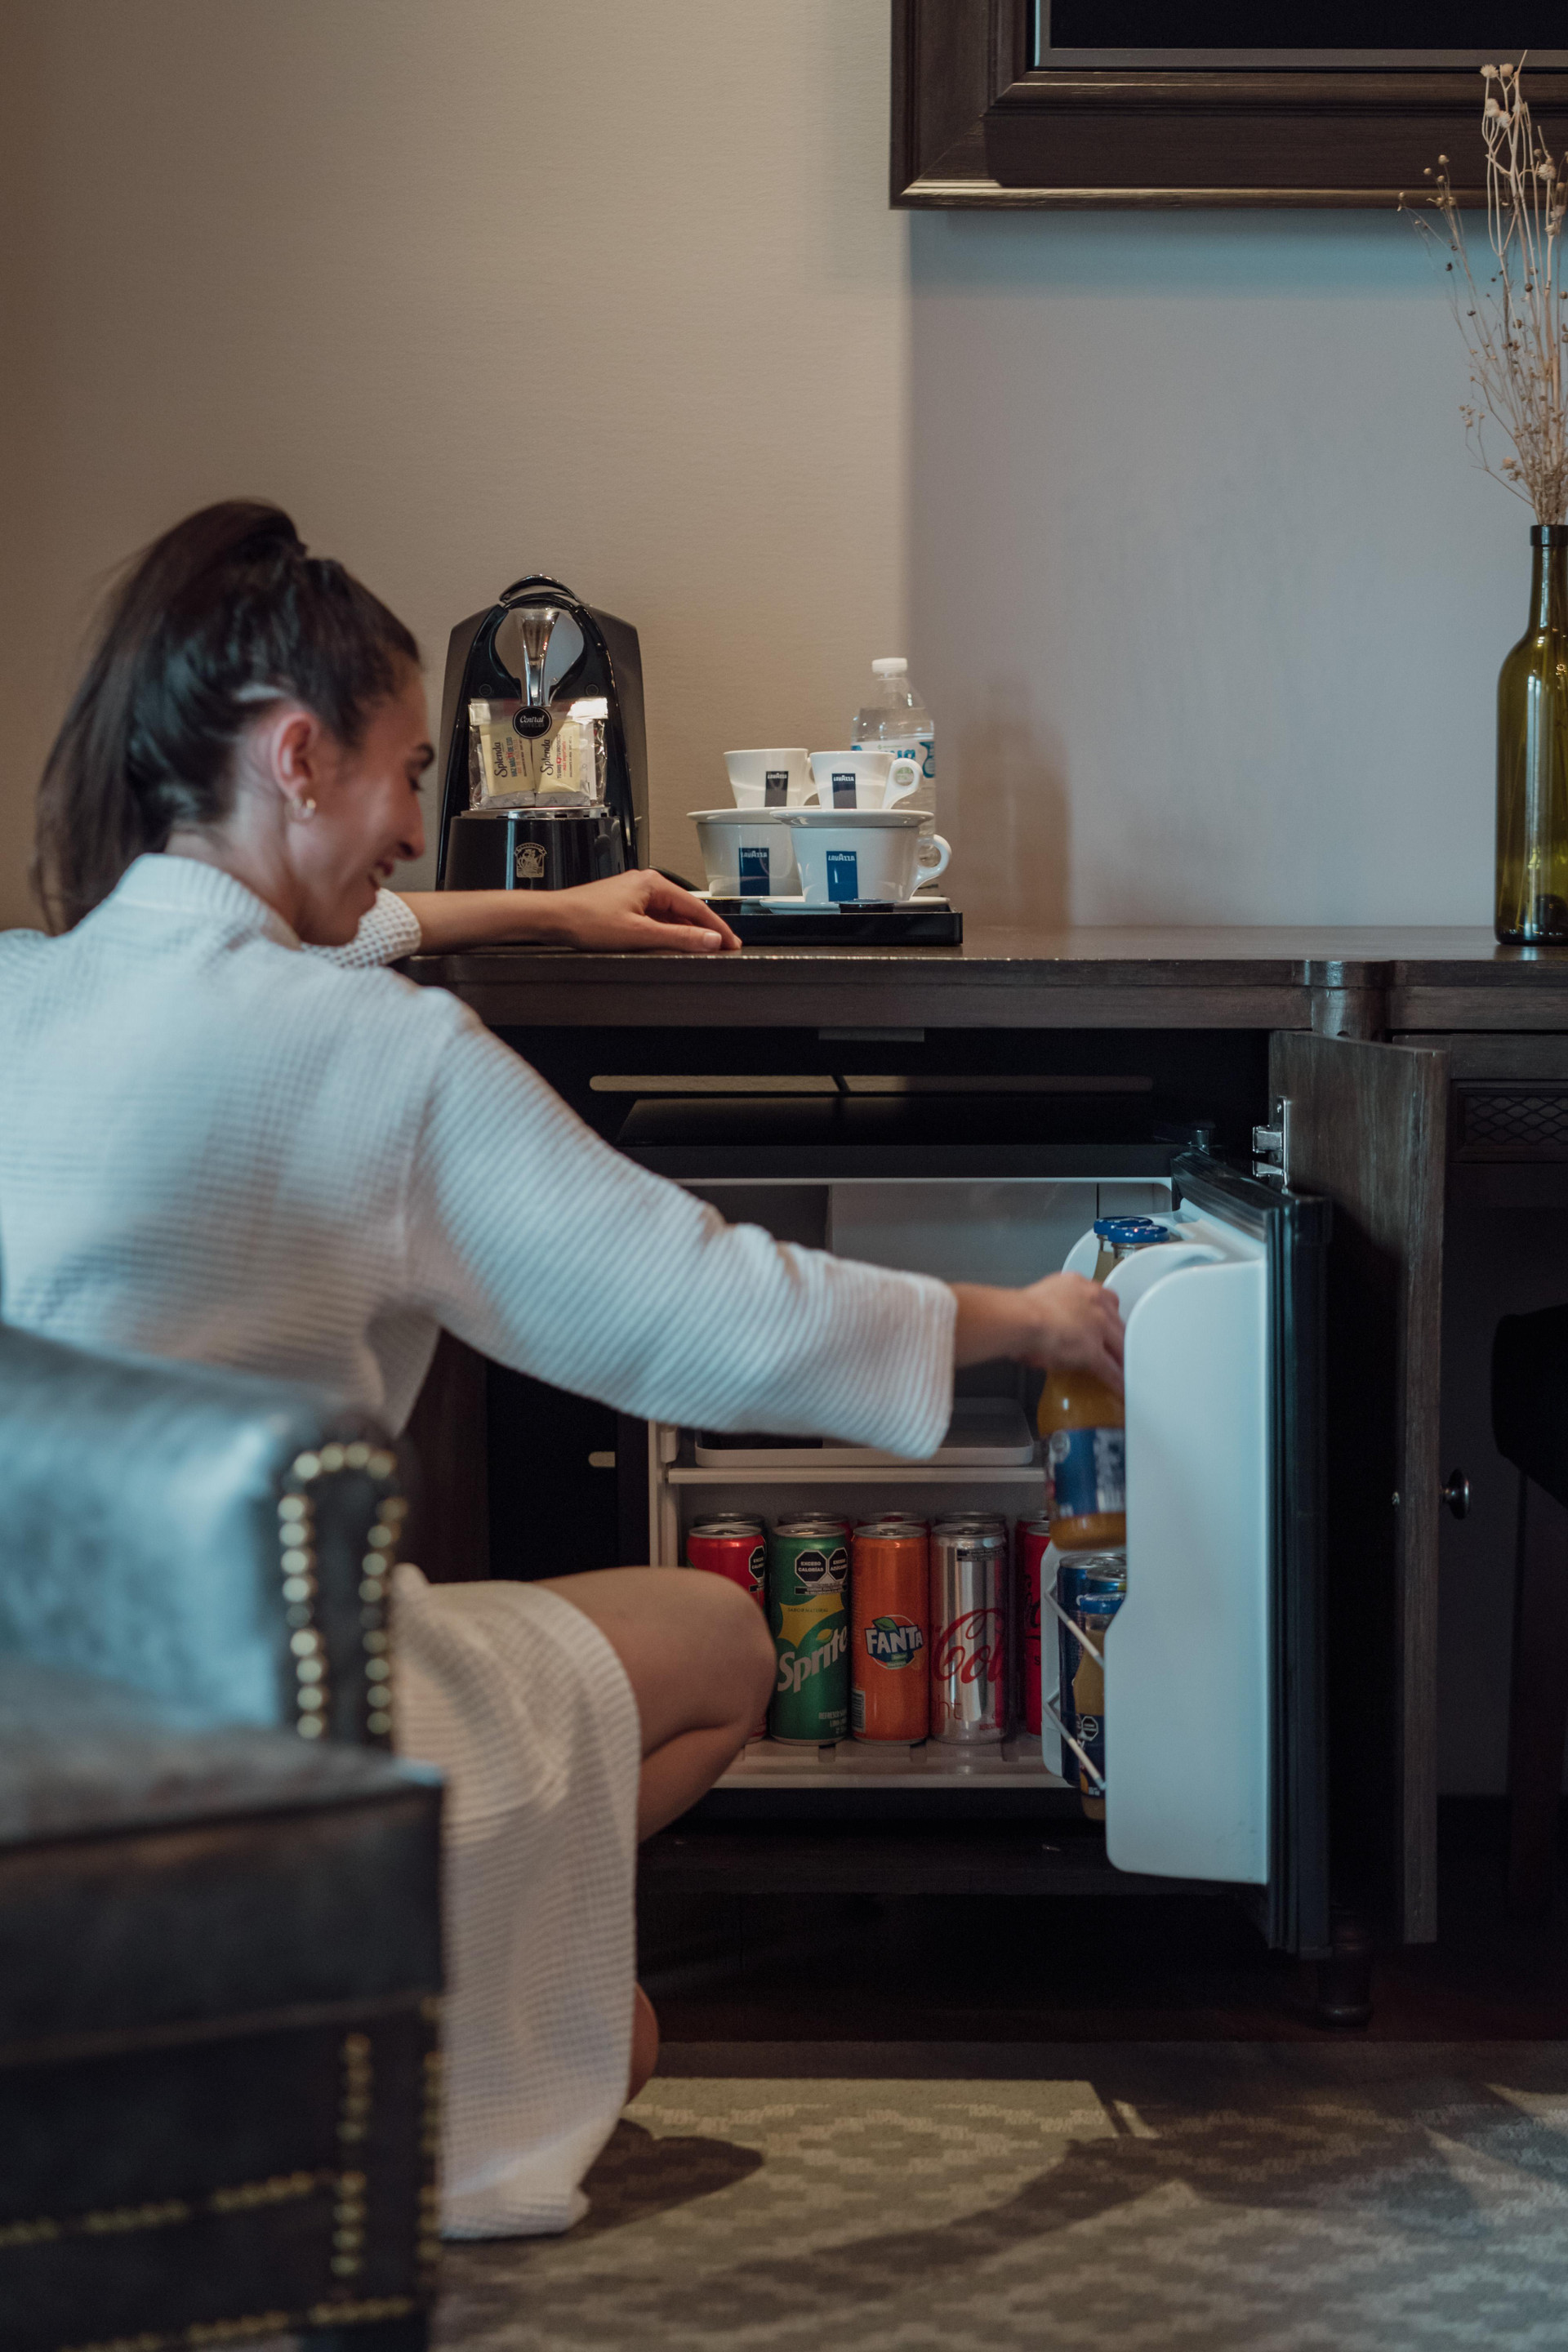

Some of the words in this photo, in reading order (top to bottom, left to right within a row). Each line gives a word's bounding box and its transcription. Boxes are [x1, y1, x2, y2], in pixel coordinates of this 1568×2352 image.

[519, 715, 545, 724] Central
[492, 742, 507, 777] Splenda
[540, 739, 554, 776] Splenda
[741, 850, 768, 858] LAVAZZA
[828, 853, 855, 862] LAVAZZA
[866, 1627, 924, 1654] FANTA
[777, 1625, 848, 1693] Sprite
